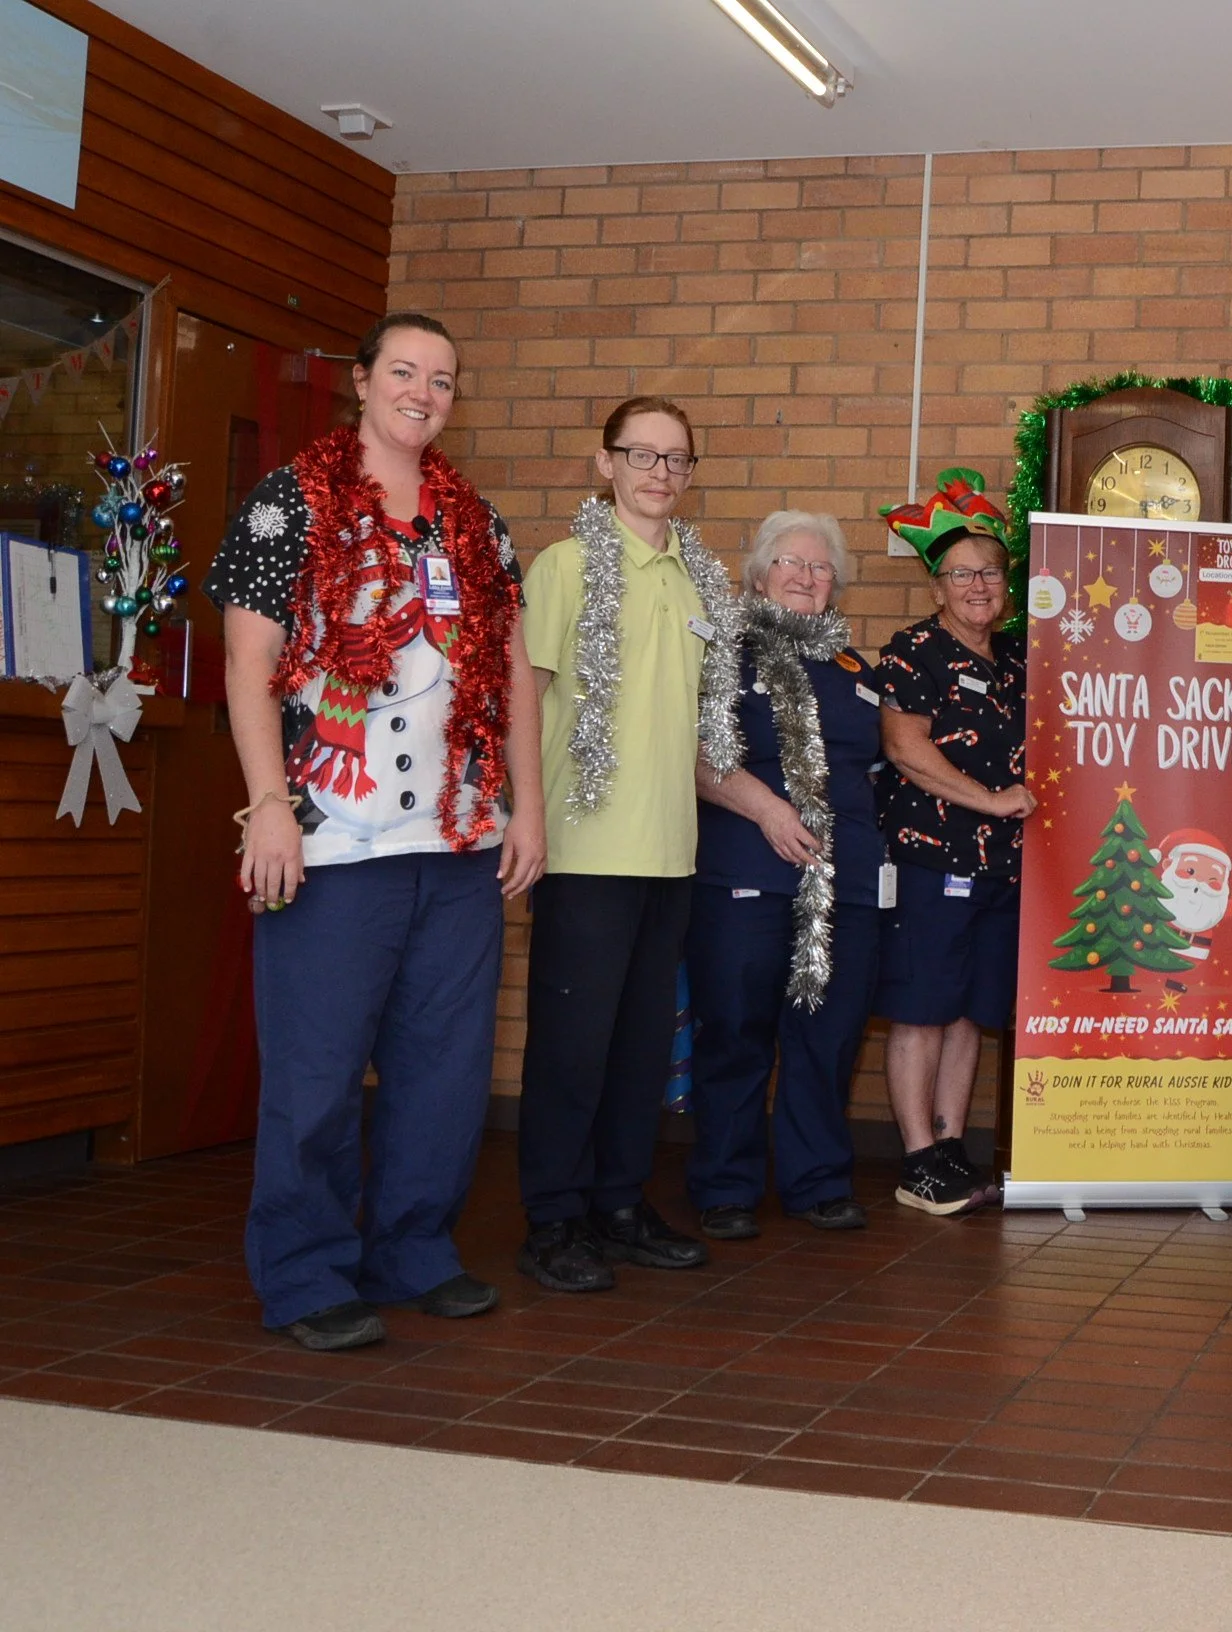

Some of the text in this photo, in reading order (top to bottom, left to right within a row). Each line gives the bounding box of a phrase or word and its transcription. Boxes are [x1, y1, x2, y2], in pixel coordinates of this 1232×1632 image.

[1120, 460, 1128, 475] 11
[1140, 454, 1152, 469] 12
[1164, 462, 1169, 475] 1
[1101, 477, 1116, 490] 10
[1178, 478, 1187, 492] 2
[1097, 498, 1106, 512] 9
[1183, 500, 1192, 513] 3
[1202, 572, 1232, 580] Location
[1059, 671, 1150, 720] SANTA
[1068, 721, 1137, 767] TOY
[1025, 1016, 1070, 1034] KIDS
[1074, 1016, 1150, 1034] IN-NEED
[1153, 1018, 1208, 1035] SANTA
[1052, 1076, 1081, 1088] DOIN
[1086, 1076, 1098, 1088] IT
[1100, 1076, 1122, 1088] FOR
[1126, 1076, 1164, 1088] RURAL
[1168, 1076, 1208, 1088] AUSSIE
[1080, 1096, 1108, 1108] proudly
[1146, 1097, 1158, 1106] the
[1093, 1112, 1110, 1120] rural
[1114, 1111, 1141, 1120] families
[1163, 1111, 1196, 1120] identified
[1200, 1111, 1210, 1122] by
[1033, 1125, 1080, 1135] Professionals
[1096, 1125, 1117, 1136] being
[1121, 1125, 1137, 1134] from
[1142, 1126, 1179, 1136] struggling
[1184, 1126, 1201, 1134] rural
[1205, 1125, 1232, 1134] families
[1068, 1140, 1086, 1149] need
[1100, 1140, 1126, 1150] helping
[1130, 1140, 1148, 1149] hand
[1152, 1140, 1170, 1148] with
